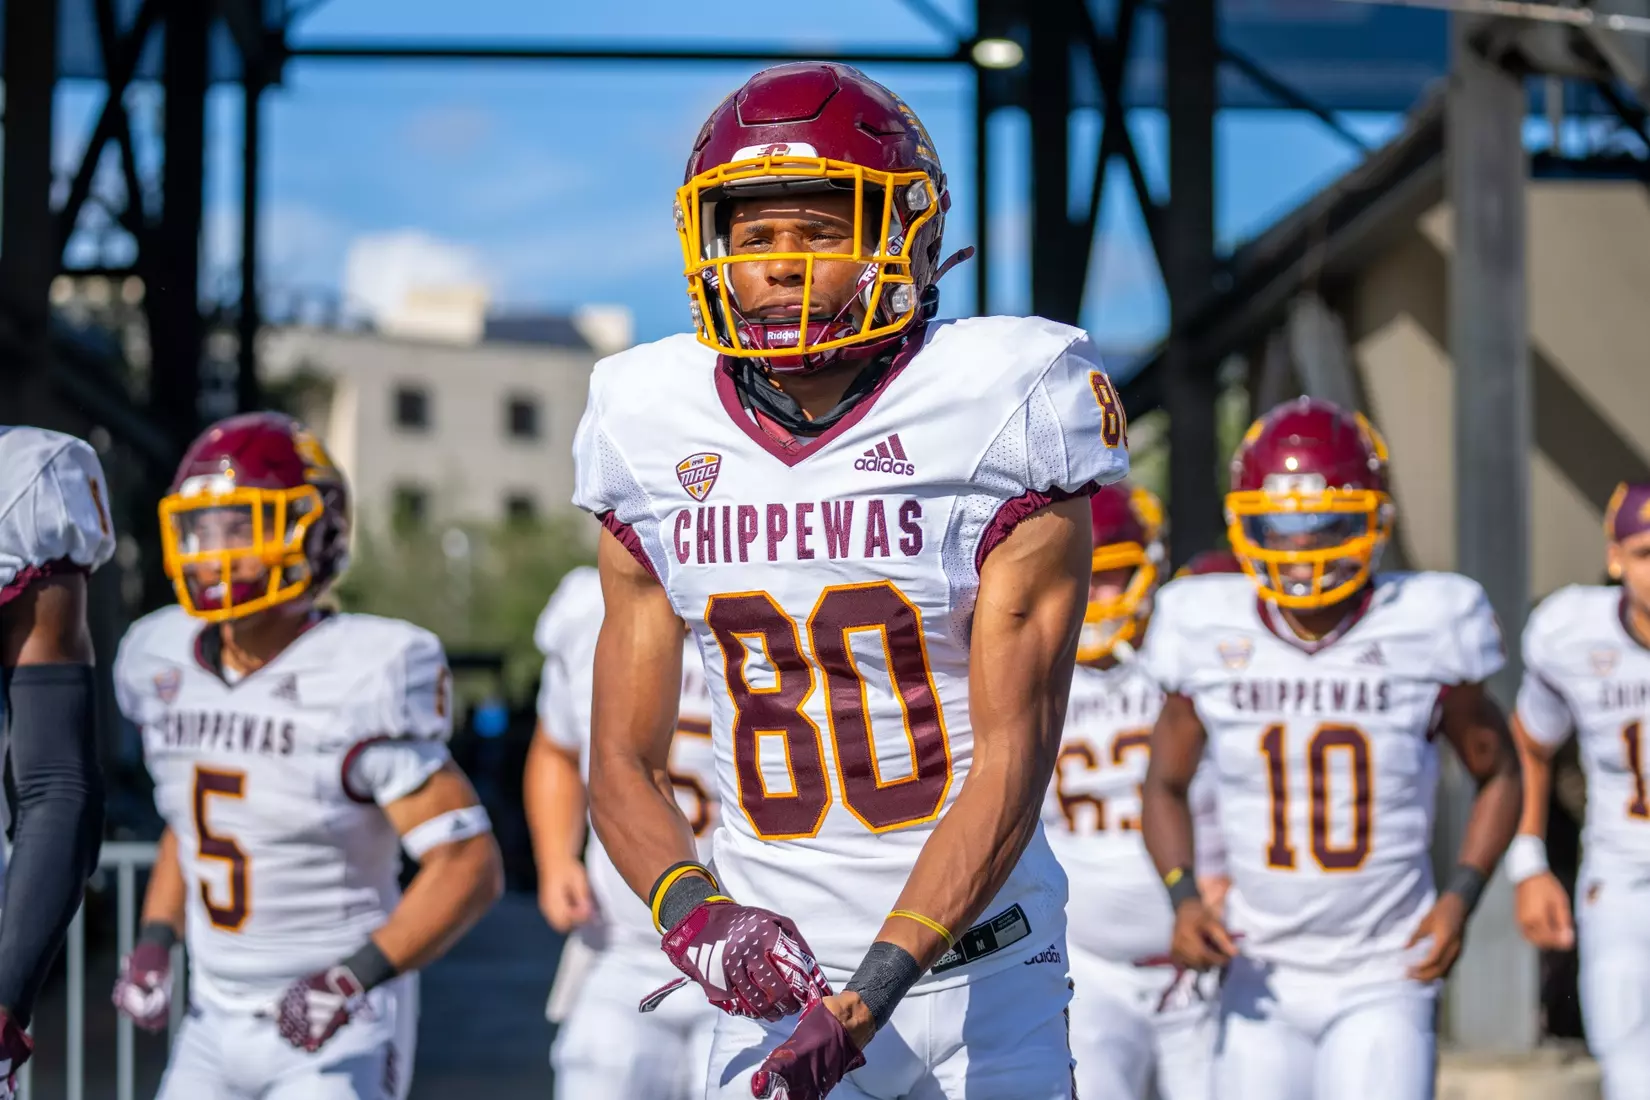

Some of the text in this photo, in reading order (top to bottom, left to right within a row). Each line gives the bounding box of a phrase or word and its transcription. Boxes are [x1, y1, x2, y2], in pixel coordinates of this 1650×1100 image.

[1088, 370, 1129, 451] 8
[680, 464, 718, 485] MAC
[854, 456, 915, 476] adidas
[673, 500, 923, 564] CHIPPEWAS
[704, 580, 954, 841] 80
[1231, 677, 1392, 712] CHIPPEWAS
[1260, 721, 1373, 873] 10
[193, 764, 250, 932] 5
[975, 938, 986, 952] M
